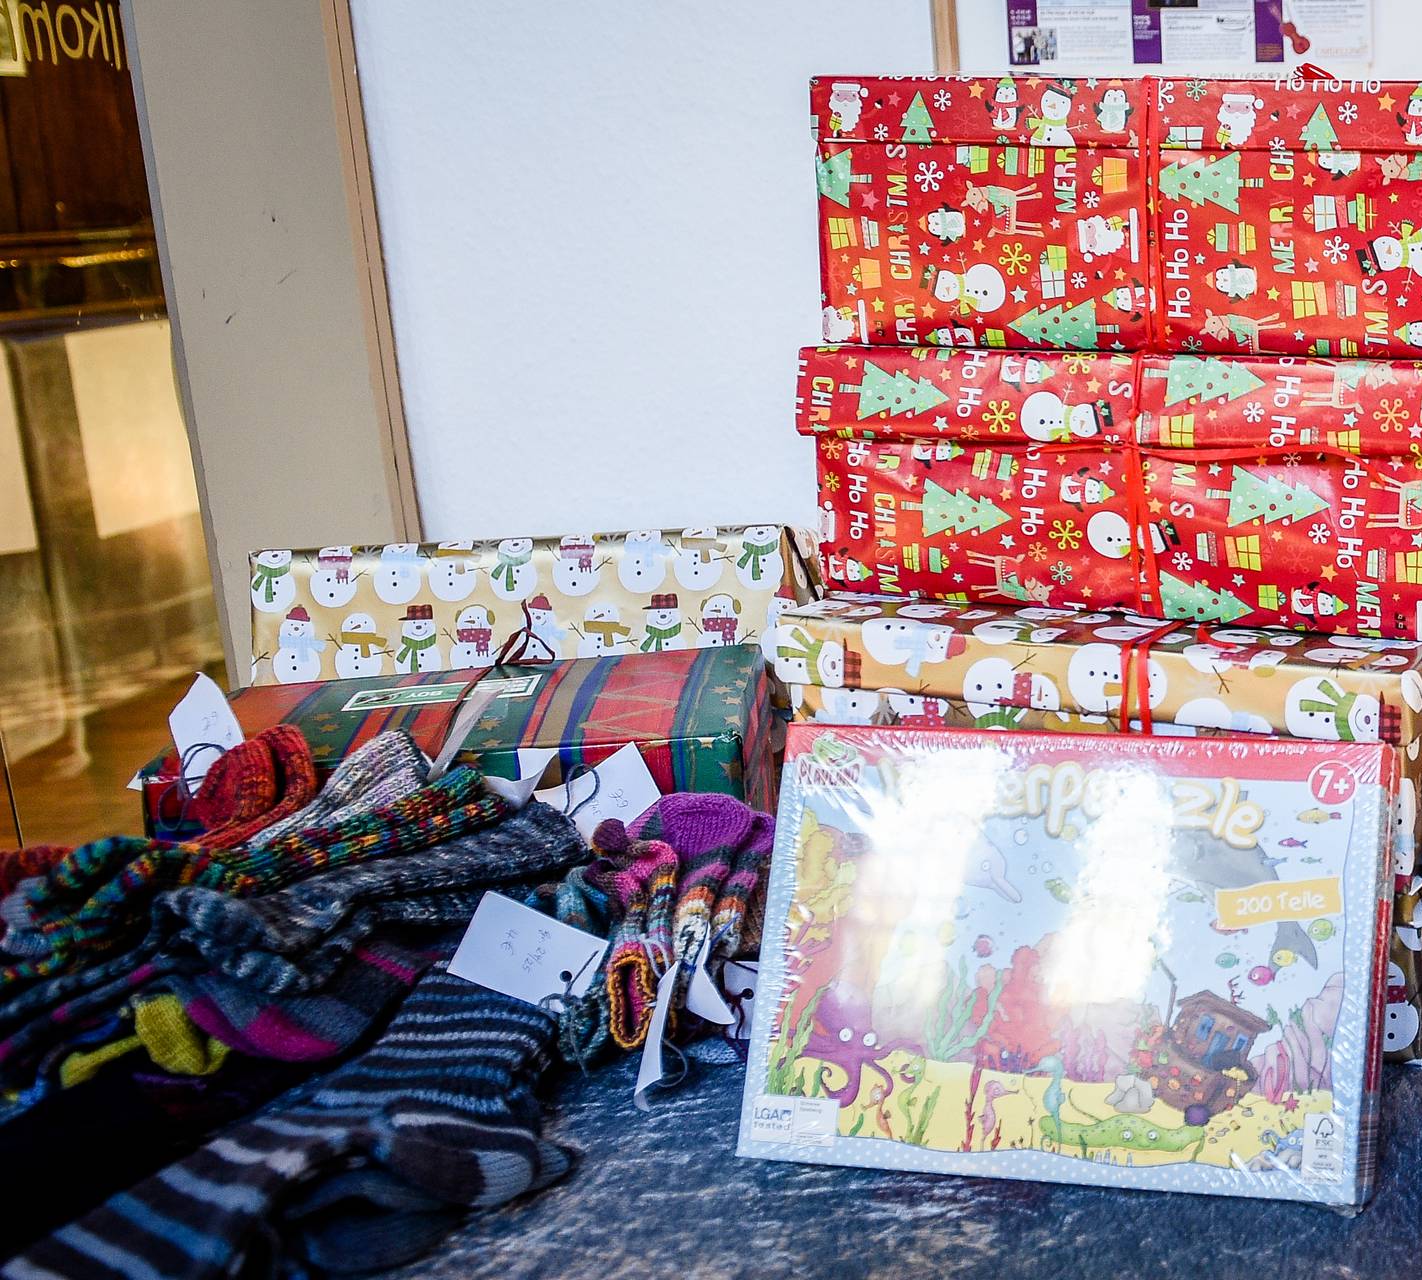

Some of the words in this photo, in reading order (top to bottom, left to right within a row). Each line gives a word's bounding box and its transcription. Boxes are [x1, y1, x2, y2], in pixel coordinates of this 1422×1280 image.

[1164, 208, 1189, 241] Ho
[1166, 248, 1190, 281] Ho
[1168, 286, 1192, 318] Ho
[956, 386, 983, 418] Ho
[1273, 373, 1302, 408] Ho
[1268, 415, 1298, 447] Ho
[846, 473, 868, 504] Ho
[1021, 467, 1049, 500] Ho
[1342, 457, 1369, 490] Ho
[848, 509, 870, 541] Ho
[1020, 505, 1045, 536] Ho
[1340, 496, 1366, 530] Ho
[1336, 536, 1364, 569] Ho
[1317, 768, 1351, 800] 7+
[1235, 895, 1273, 917] 200
[1278, 889, 1328, 911] Teile
